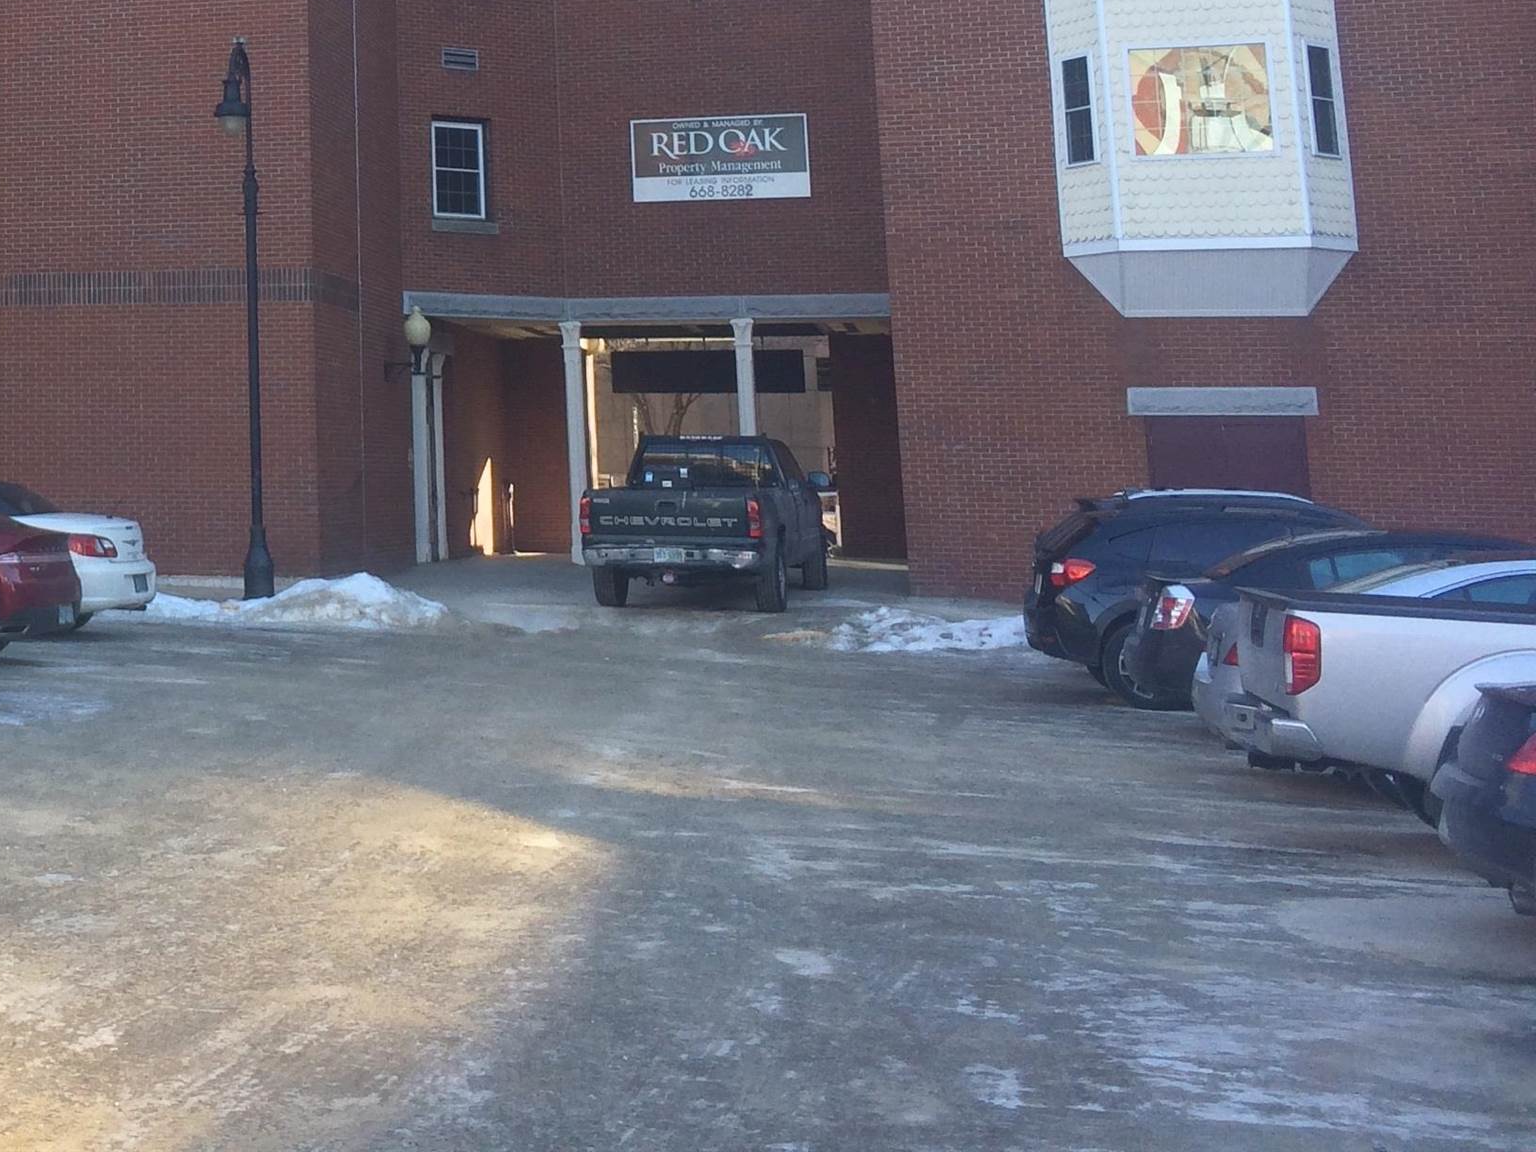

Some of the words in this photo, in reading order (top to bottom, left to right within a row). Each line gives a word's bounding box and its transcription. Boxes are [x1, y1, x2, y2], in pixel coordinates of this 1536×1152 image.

[711, 119, 751, 128] MANAGED
[650, 130, 714, 160] RED
[718, 127, 788, 154] OAK
[658, 162, 706, 175] Property
[711, 160, 781, 173] Management
[667, 178, 682, 186] FOR
[685, 176, 718, 185] LEASING
[721, 175, 775, 184] INFORMATION
[689, 184, 754, 198] 668-8282
[599, 515, 738, 528] CHEVROLET
